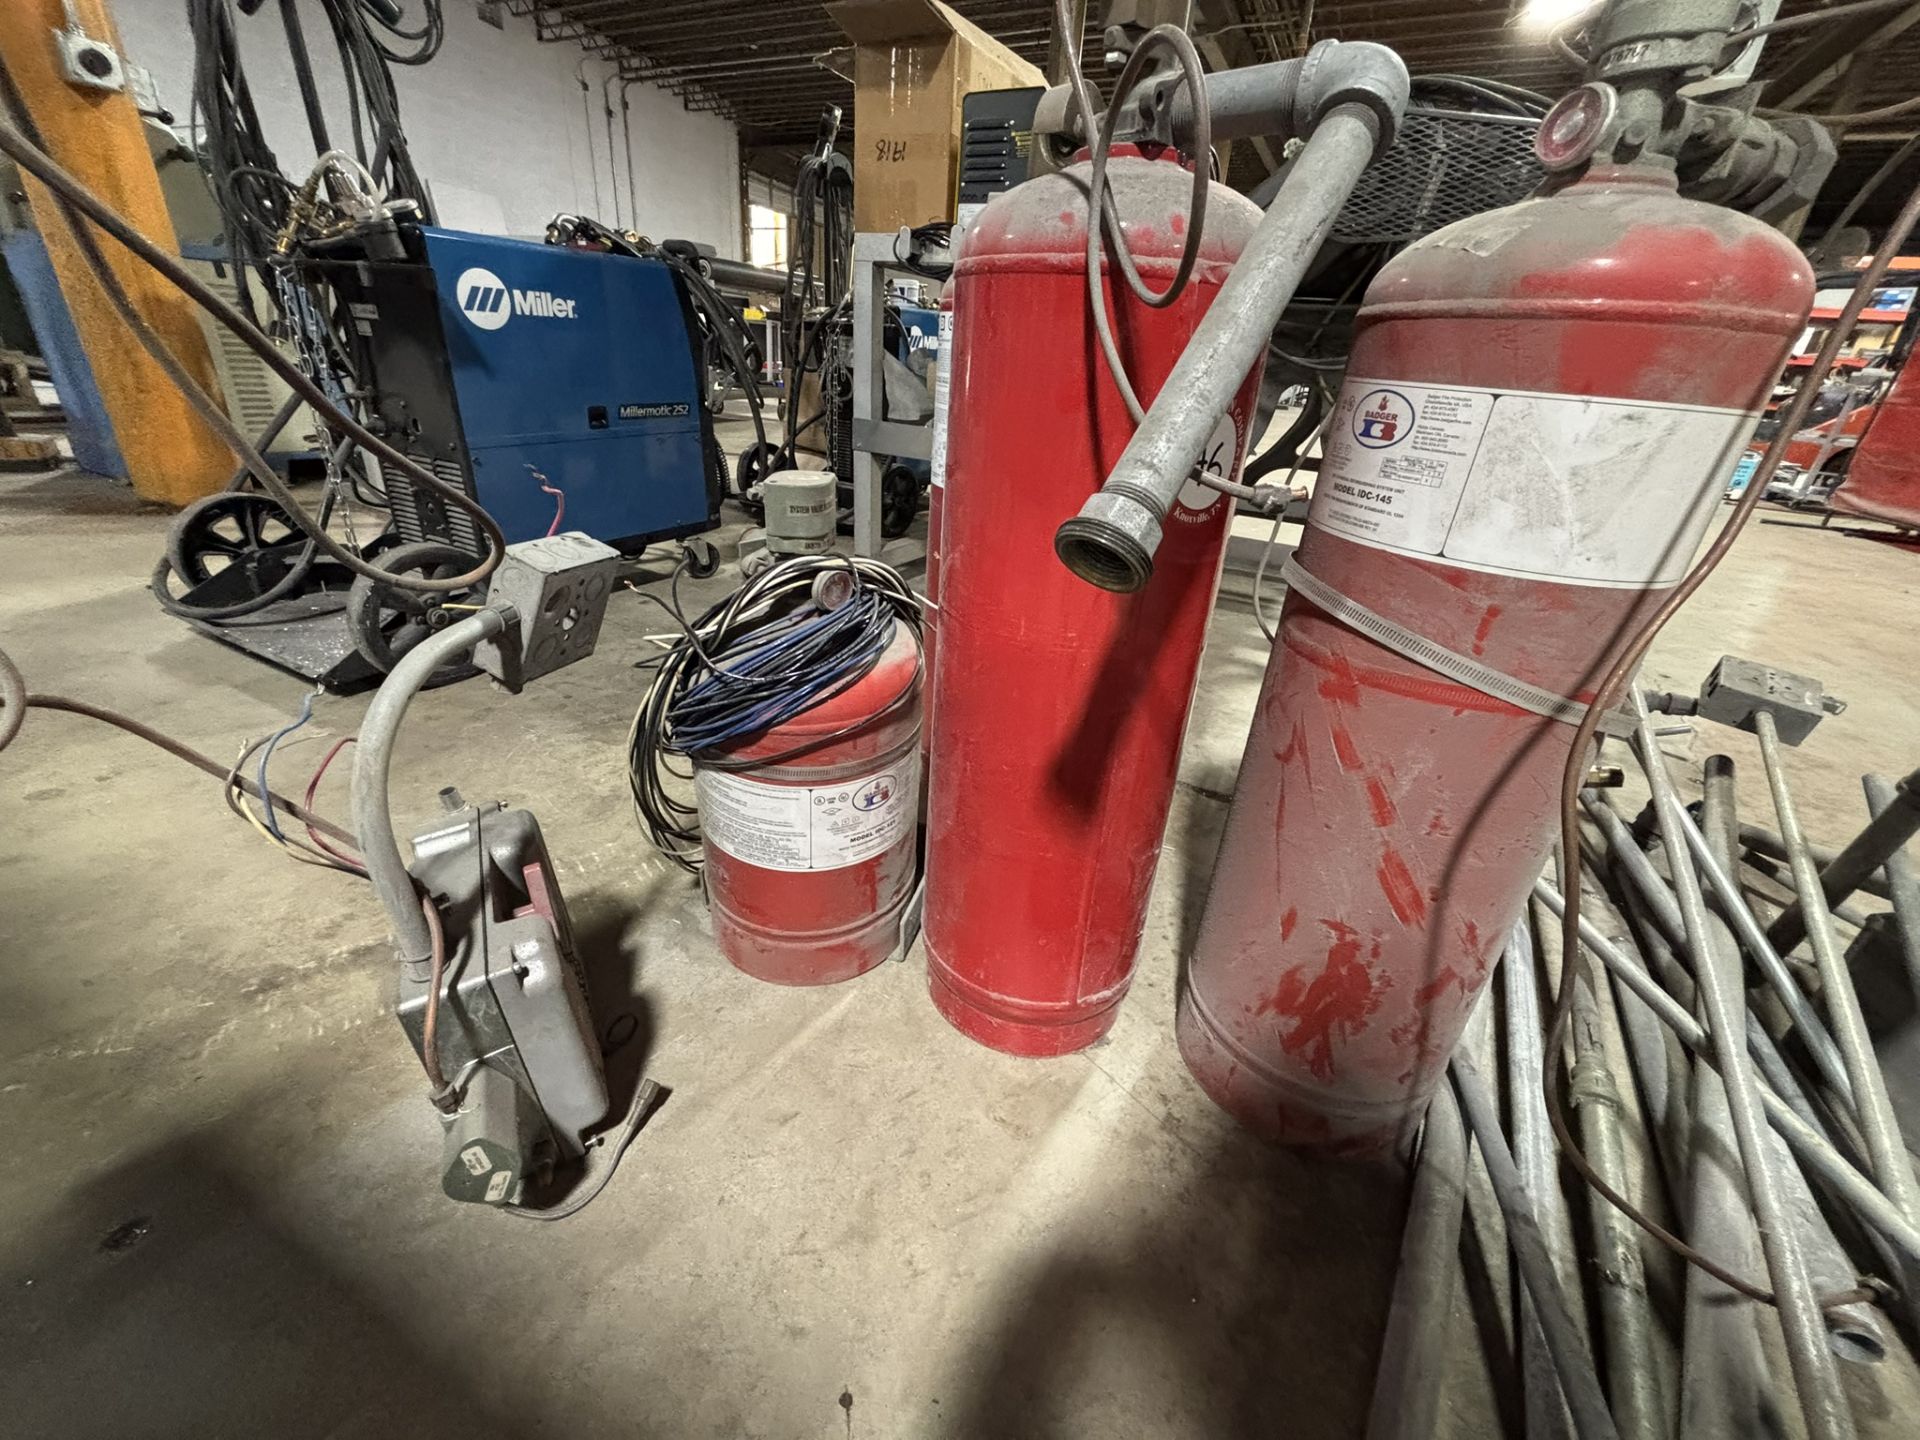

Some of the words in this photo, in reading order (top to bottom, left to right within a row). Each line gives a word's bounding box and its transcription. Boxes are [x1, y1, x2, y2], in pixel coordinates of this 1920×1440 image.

[512, 289, 577, 319] Miller
[672, 403, 689, 416] 252
[1364, 411, 1399, 422] BADGER
[1333, 482, 1356, 497] MODEL
[1357, 488, 1393, 505] IDC-145
[850, 831, 873, 843] MODEL
